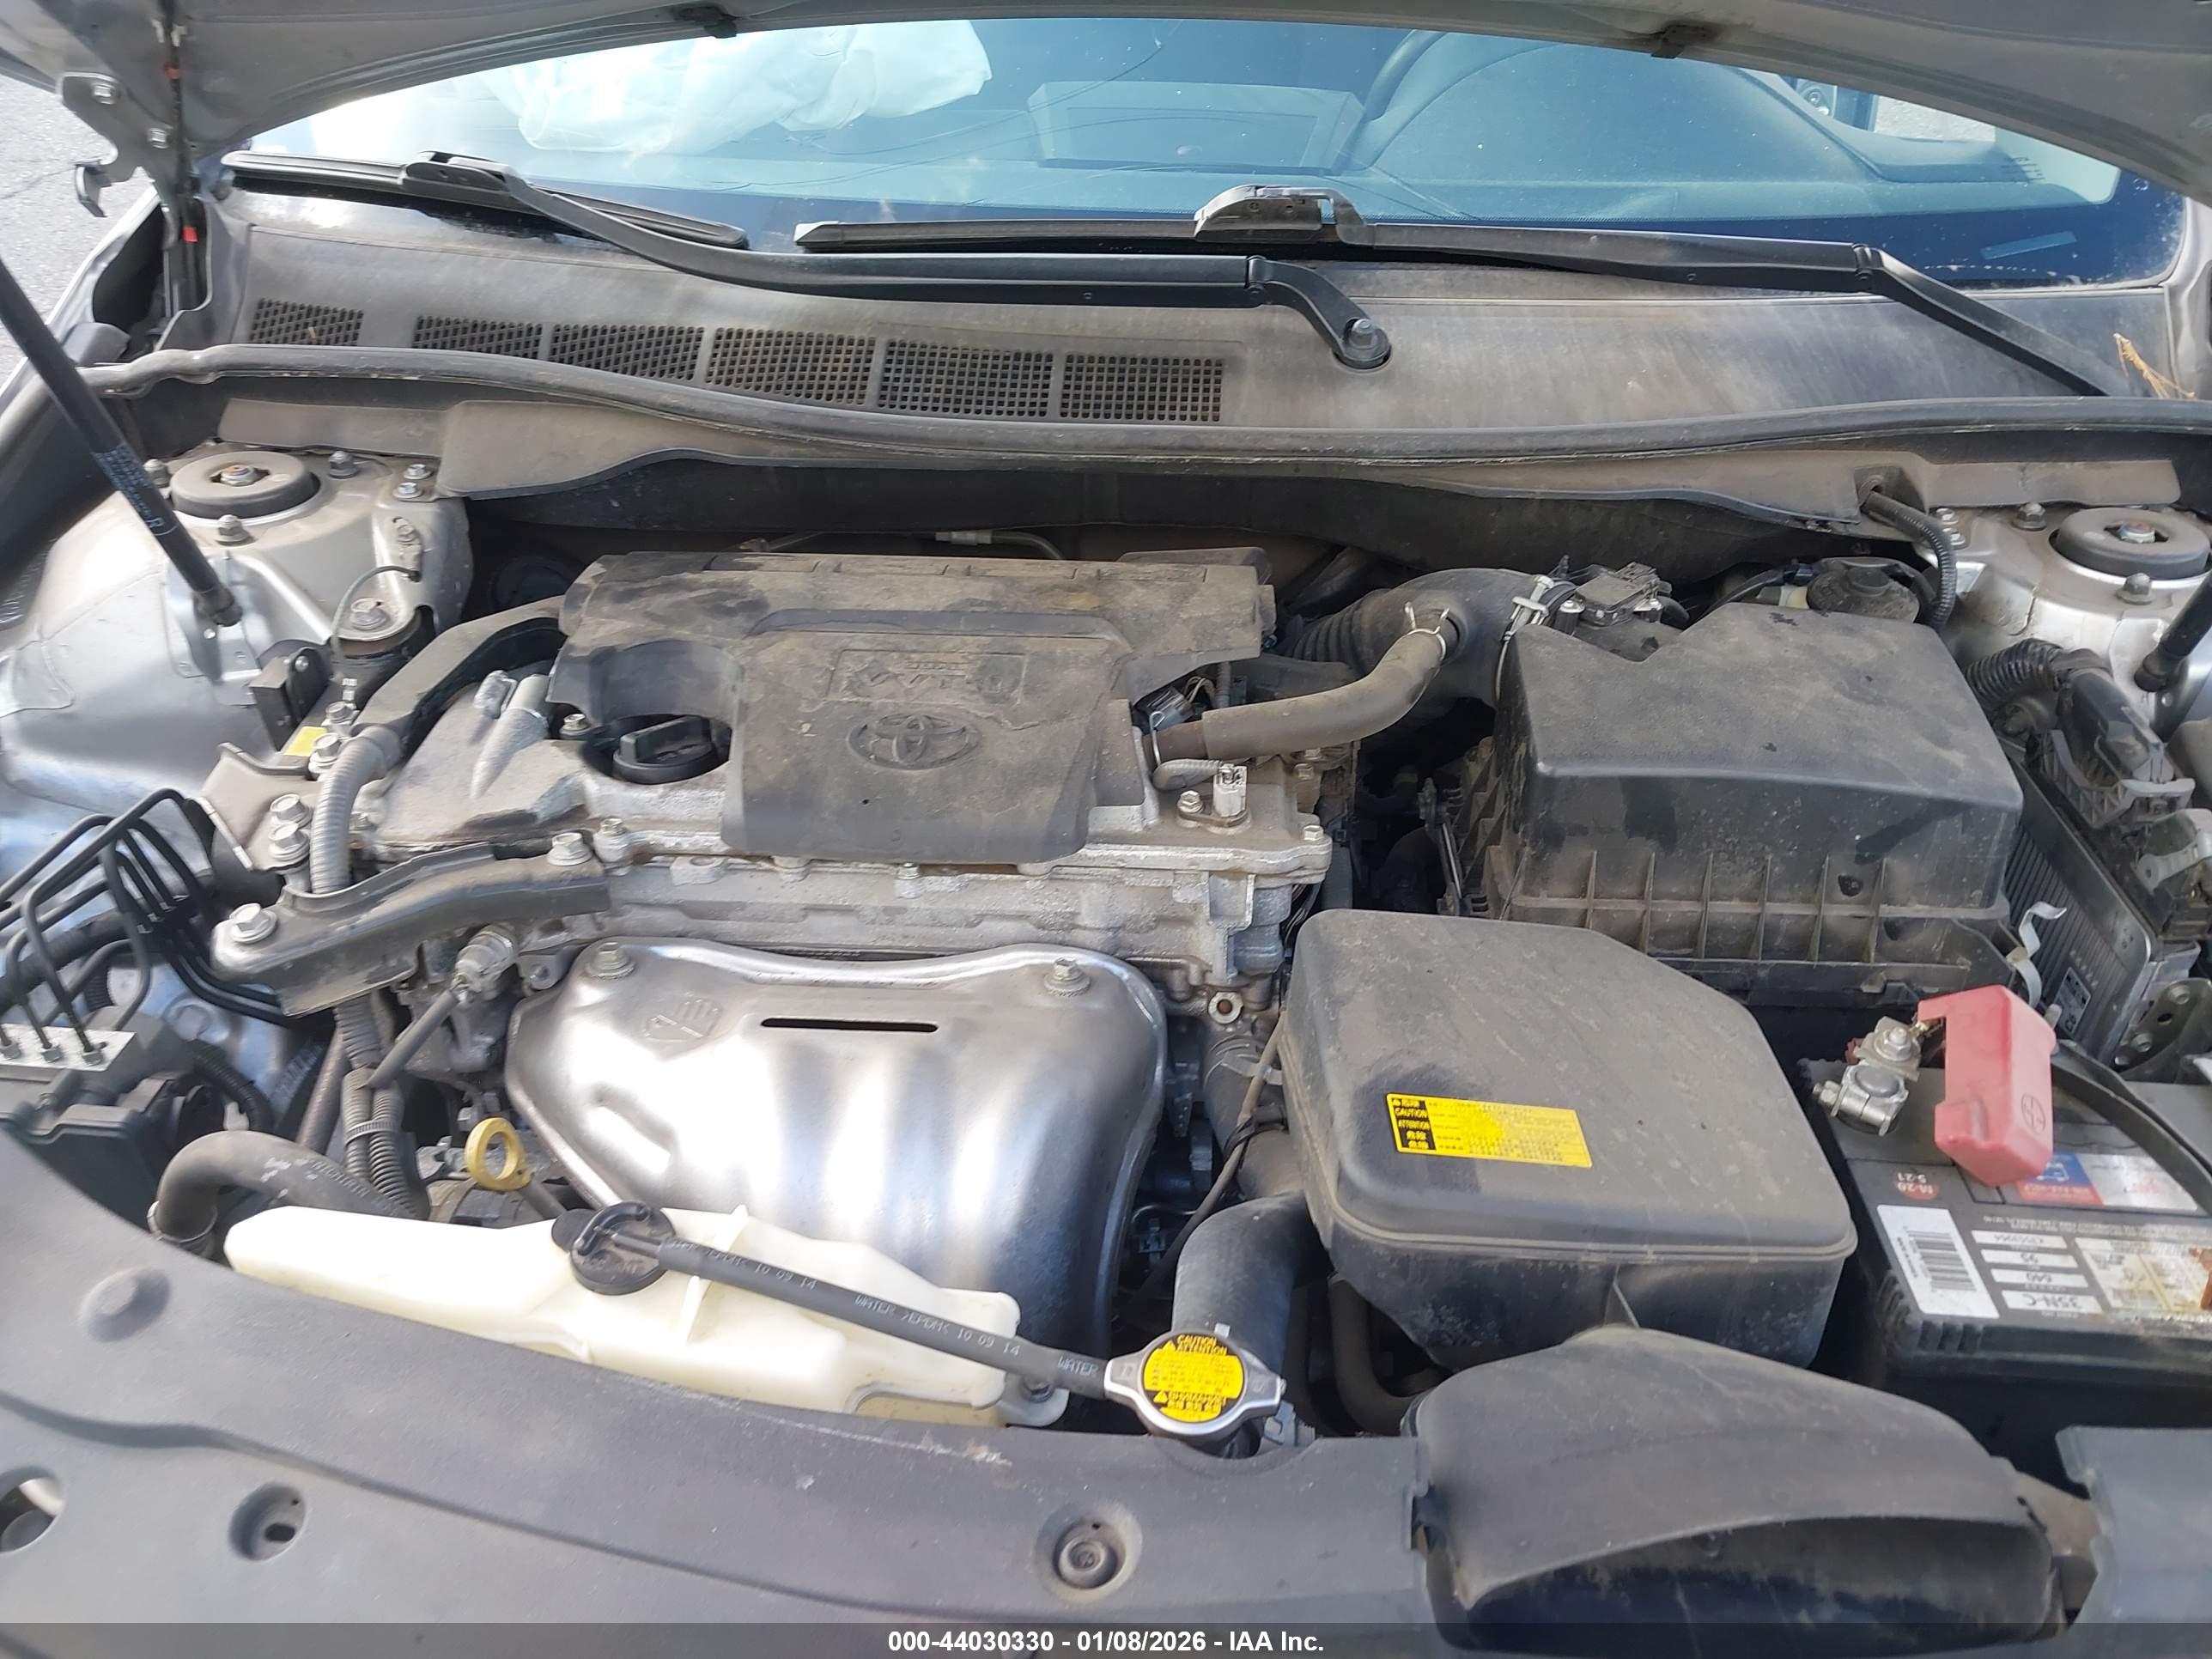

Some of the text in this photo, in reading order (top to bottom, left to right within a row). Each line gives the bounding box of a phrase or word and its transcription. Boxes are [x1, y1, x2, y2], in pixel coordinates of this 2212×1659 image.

[854, 1294, 896, 1316] WATER
[957, 1328, 972, 1340] 10
[1003, 1342, 1021, 1356] 14
[1177, 1334, 1217, 1347] CAUTION
[1058, 1356, 1099, 1376] WATER
